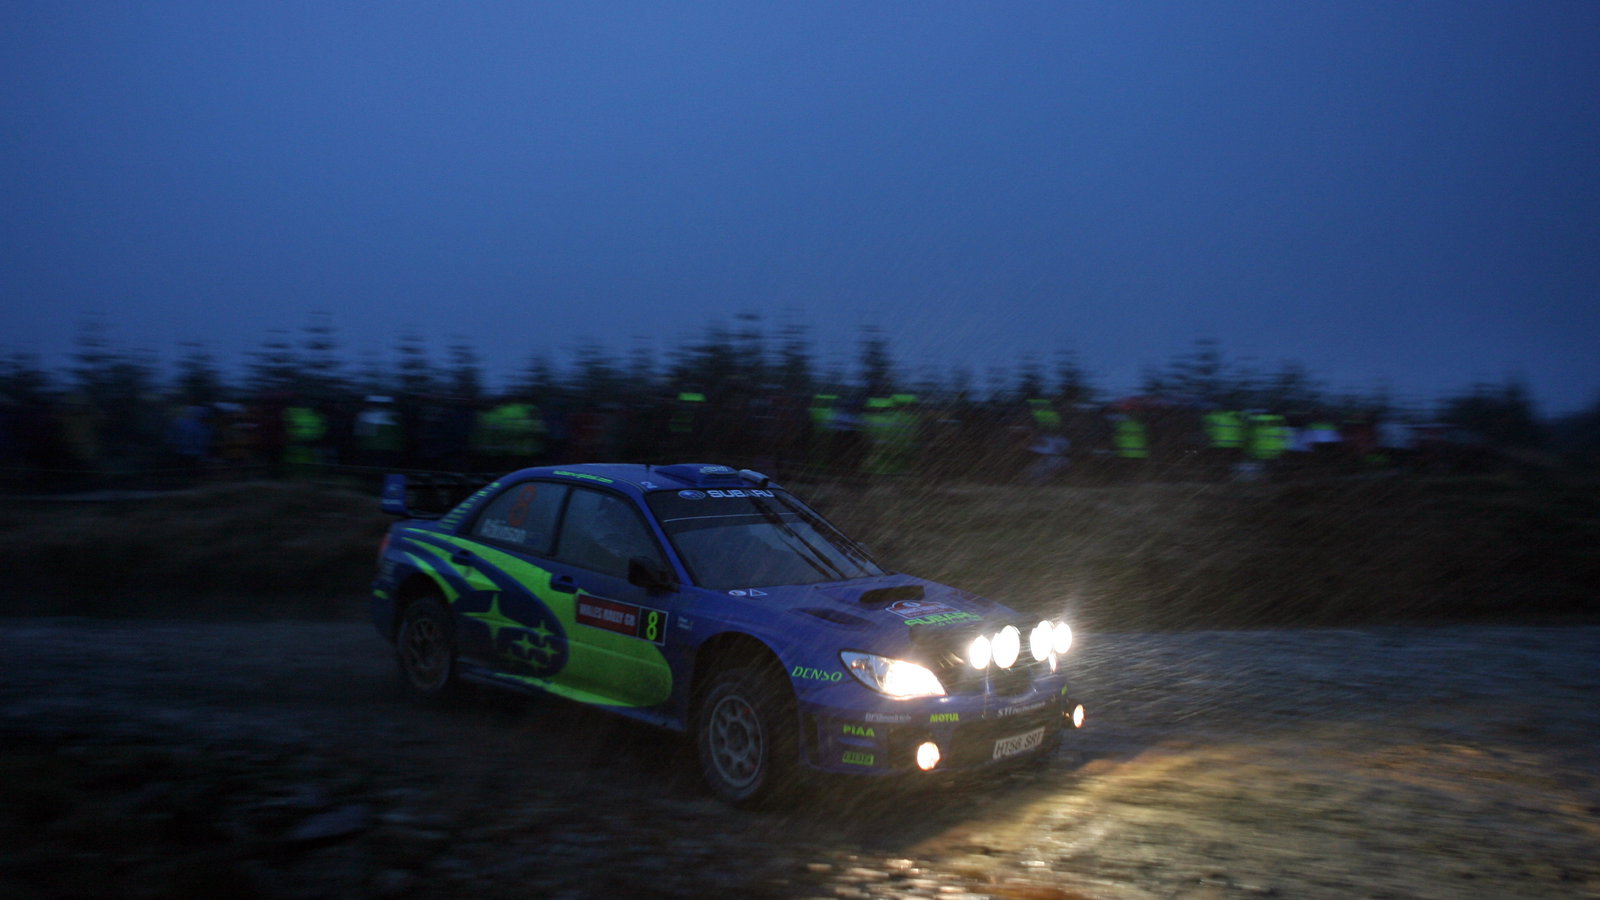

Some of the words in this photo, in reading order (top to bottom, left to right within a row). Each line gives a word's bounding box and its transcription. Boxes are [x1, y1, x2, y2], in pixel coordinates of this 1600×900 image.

[708, 489, 776, 498] SUBARU
[509, 486, 536, 526] 8
[646, 611, 659, 641] 8
[791, 666, 843, 682] DENSO
[929, 712, 960, 723] MOTUL
[843, 725, 875, 737] PIAA
